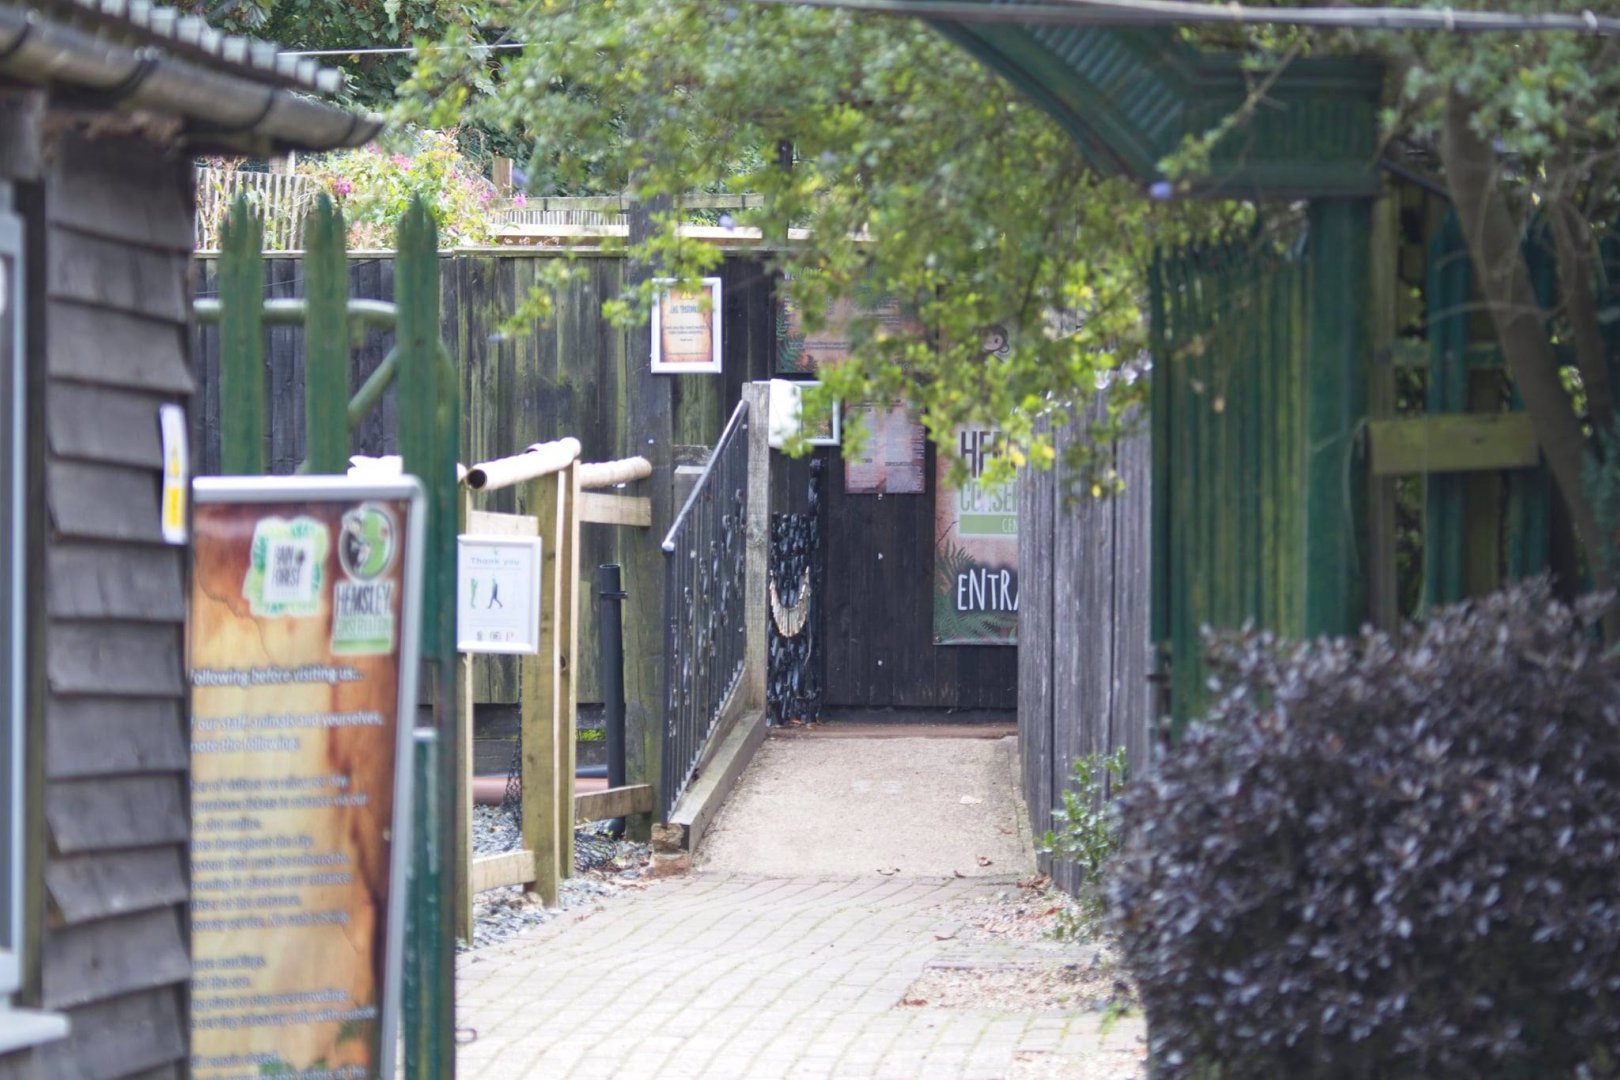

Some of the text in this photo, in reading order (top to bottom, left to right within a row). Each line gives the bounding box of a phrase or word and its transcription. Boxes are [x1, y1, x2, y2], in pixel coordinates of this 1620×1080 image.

[471, 557, 520, 567] Thank you
[335, 584, 391, 616] HEMSLEY
[250, 667, 292, 685] before
[293, 665, 337, 687] visiting
[198, 719, 217, 731] our
[299, 713, 320, 728] and
[221, 736, 241, 752] the
